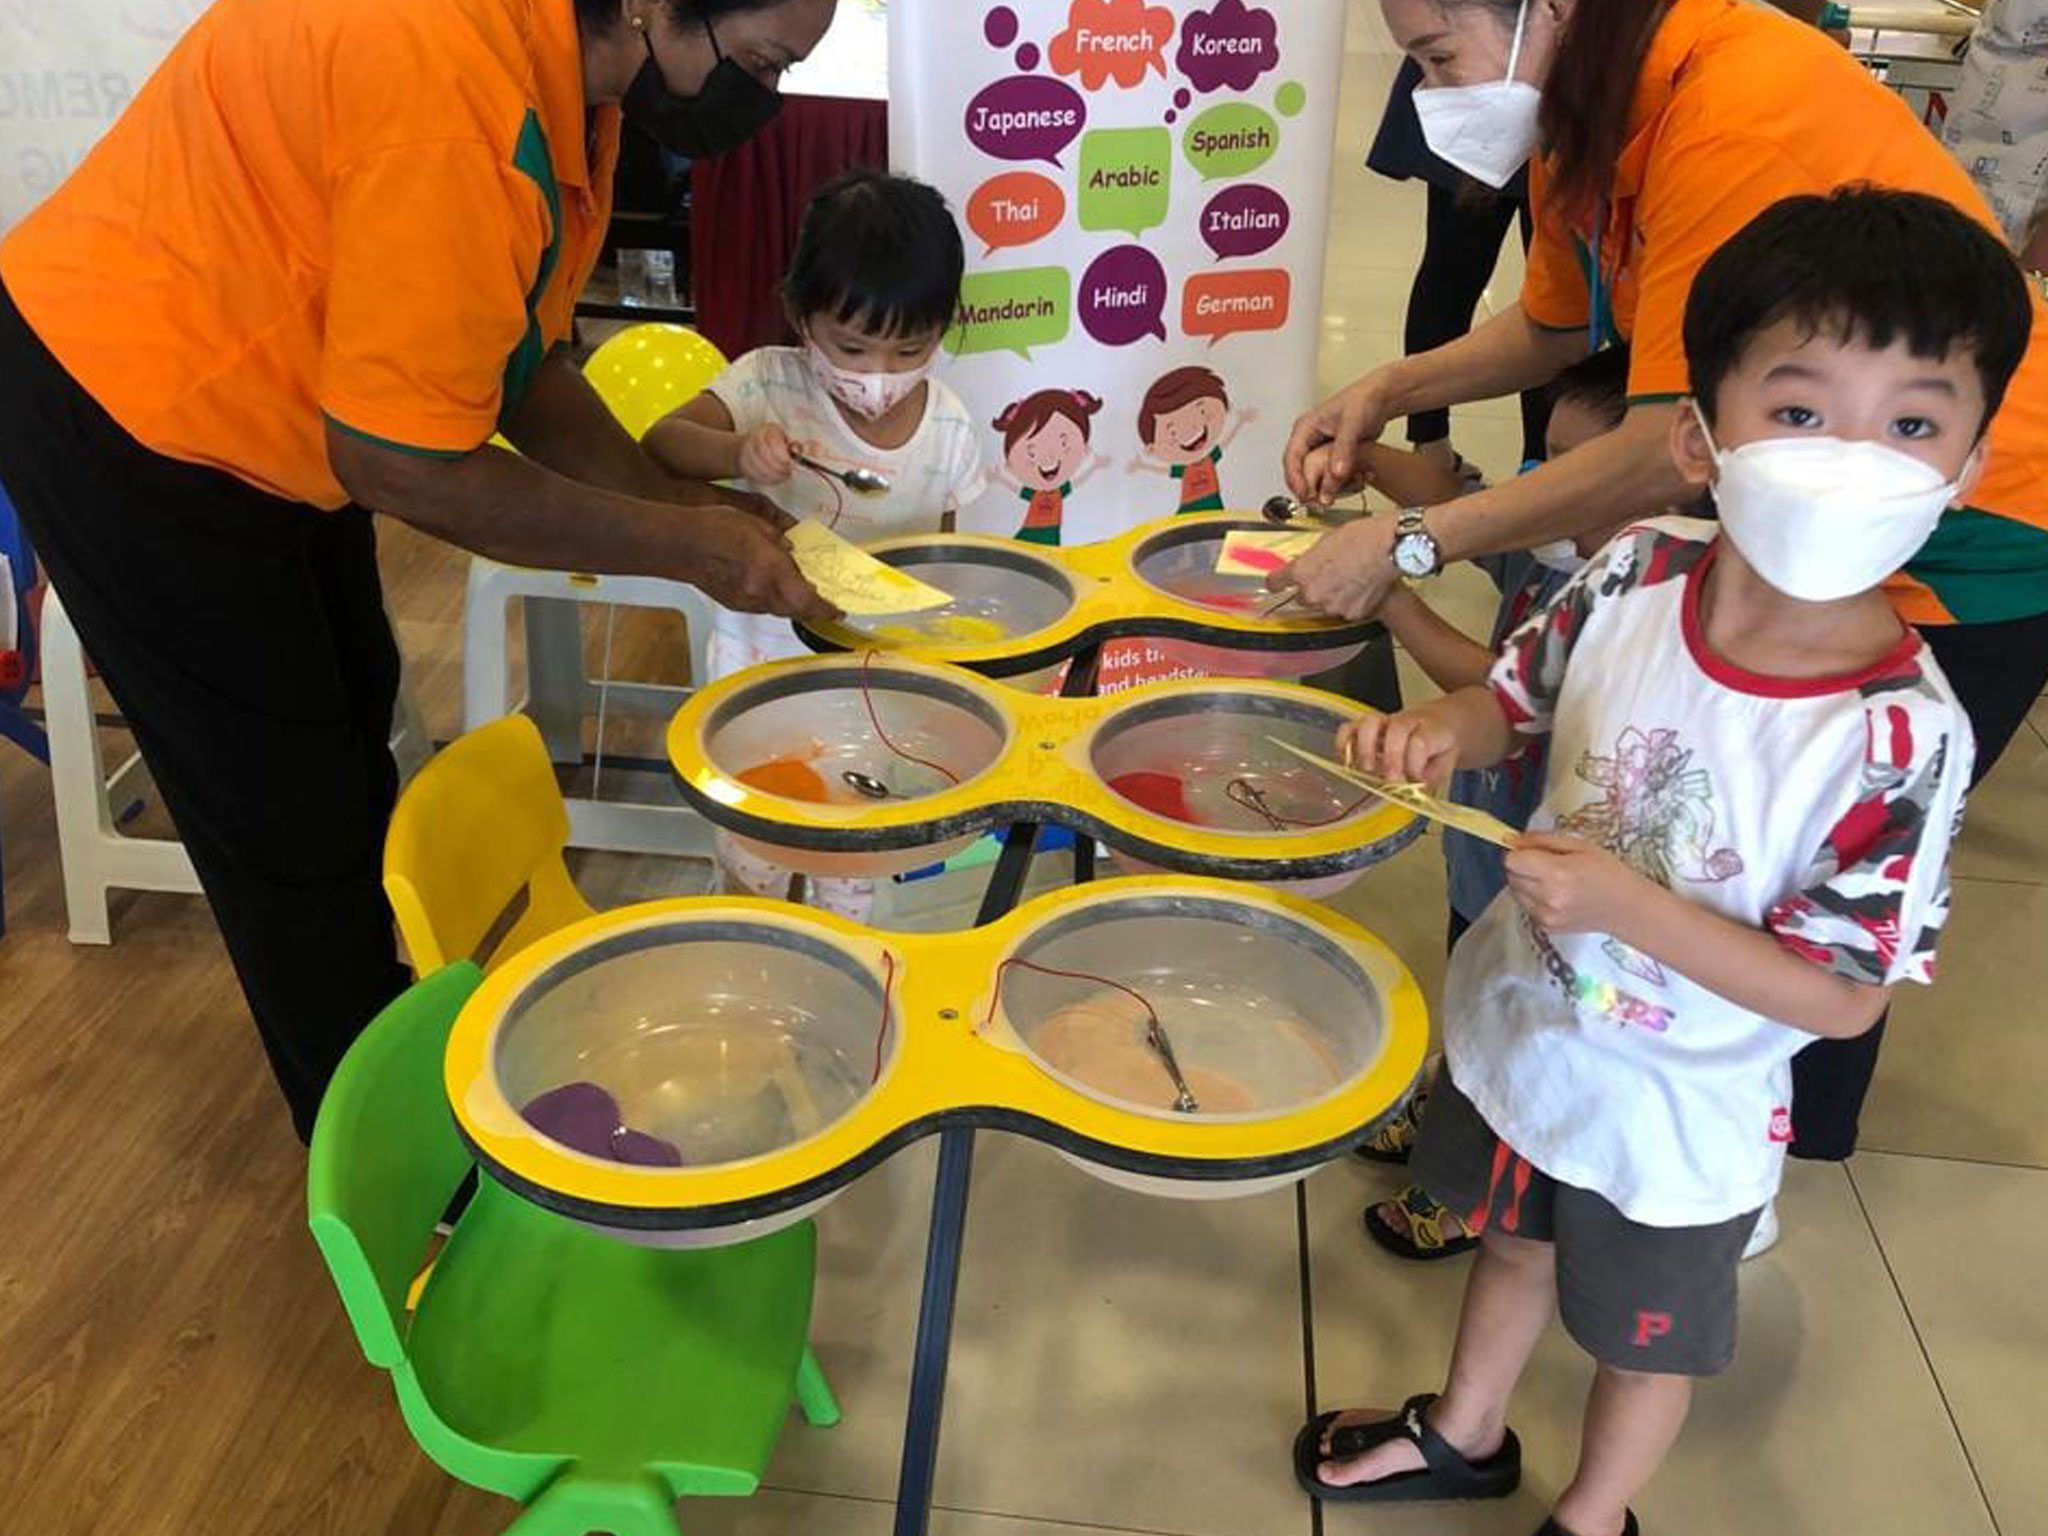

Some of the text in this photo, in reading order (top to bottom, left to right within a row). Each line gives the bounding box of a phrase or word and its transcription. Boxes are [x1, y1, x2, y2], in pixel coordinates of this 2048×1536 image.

[1076, 30, 1153, 54] French
[1192, 32, 1262, 56] Korean
[973, 105, 1077, 137] Japanese
[1191, 124, 1270, 156] Spanish
[1089, 163, 1160, 189] Arabic
[991, 199, 1038, 221] Thai
[1208, 209, 1280, 231] Italian
[1094, 285, 1147, 308] Hindi
[1196, 292, 1274, 315] German
[958, 297, 1054, 326] Mandarin
[1102, 648, 1140, 670] kids
[1632, 1310, 1671, 1346] P
